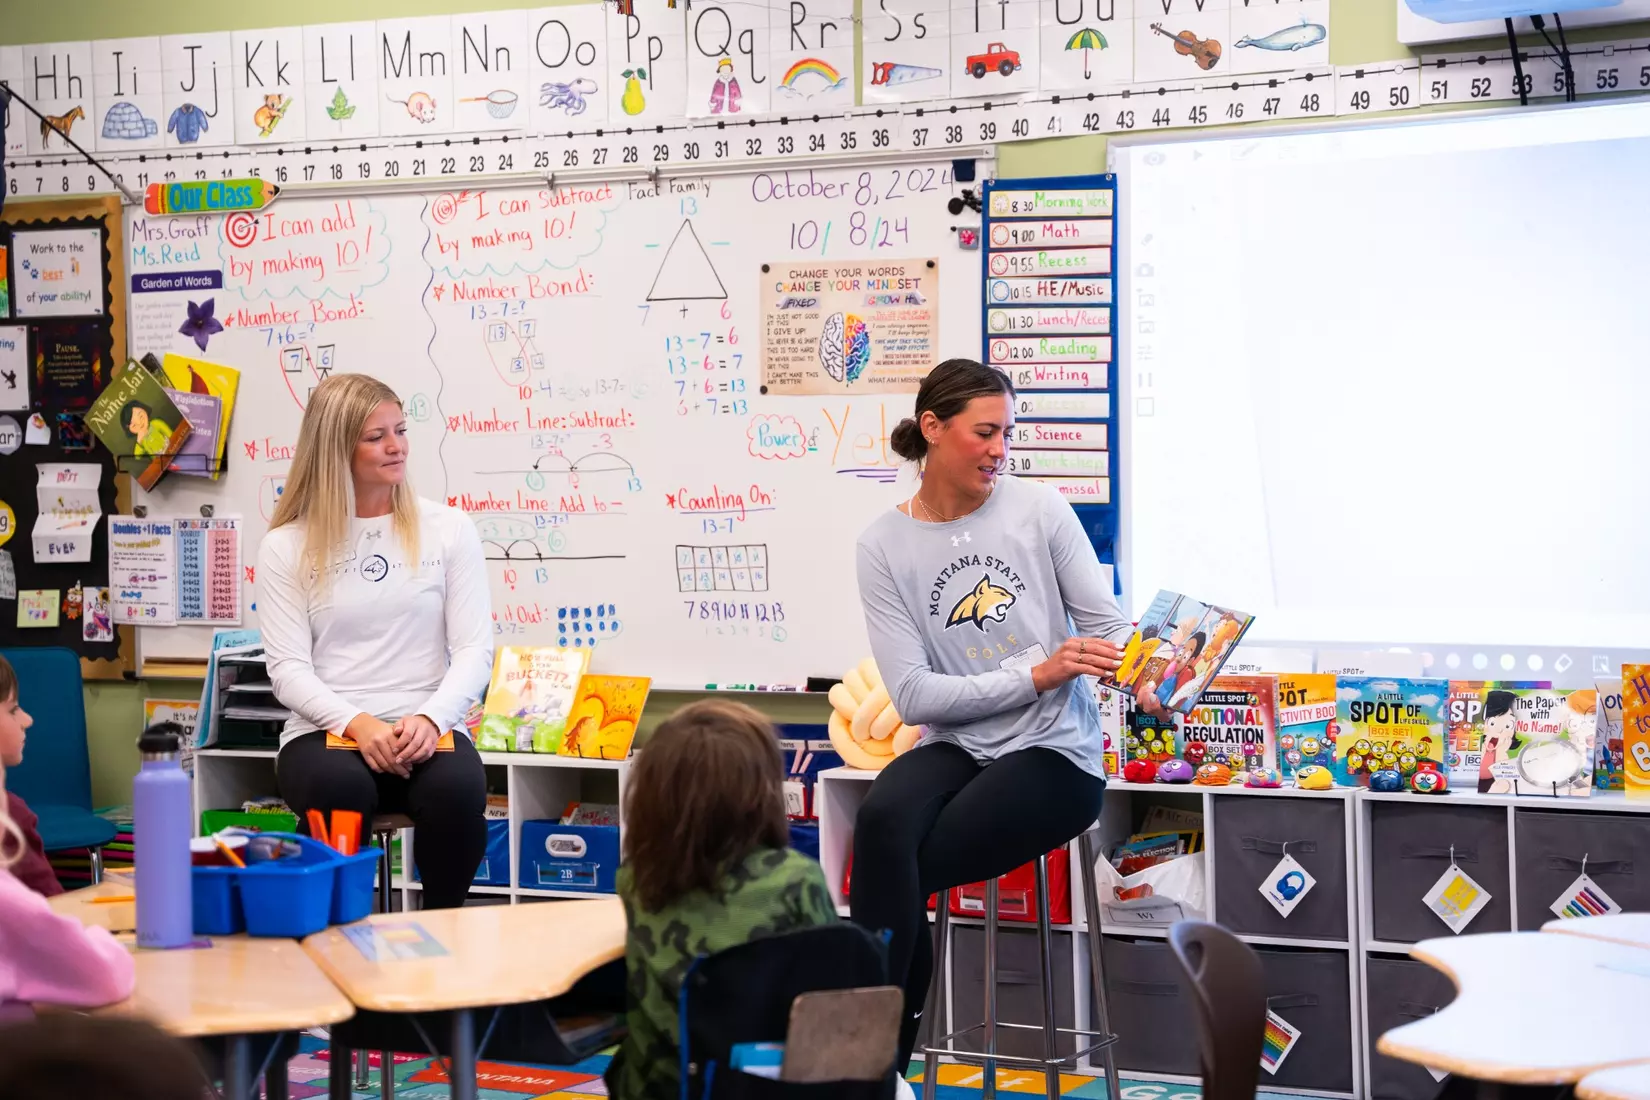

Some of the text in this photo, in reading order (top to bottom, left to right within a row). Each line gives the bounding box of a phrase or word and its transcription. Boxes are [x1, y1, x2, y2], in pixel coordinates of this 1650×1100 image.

[34, 54, 82, 100] Hh
[112, 51, 137, 96] Ii
[180, 46, 218, 117] Jj
[245, 40, 291, 87] Kk
[383, 30, 445, 78] Mm
[463, 24, 510, 73] Nn
[536, 20, 596, 68] Oo
[626, 15, 662, 90] Pp
[694, 7, 766, 83] Qq
[790, 2, 836, 50] Rr
[880, 0, 926, 41] Ss
[11, 69, 1618, 194] 6 7 8 9 11 16 18 20 21 23 25 27 29 30 32 34 36 38 40 42 44 46 47 48 49 50 51 52 55
[169, 182, 253, 210] Our Class
[628, 181, 660, 200] Fact
[752, 168, 955, 205] October 8, 2024
[475, 183, 612, 221] I can Subtract
[1034, 192, 1083, 214] Morning
[263, 200, 356, 241] I can add
[436, 210, 576, 260] by making 10!
[1042, 224, 1080, 238] Math
[30, 243, 84, 255] Work to the
[230, 255, 253, 285] by
[263, 249, 326, 282] making
[1038, 251, 1087, 268] Recess
[141, 276, 212, 289] Garden of Words
[789, 267, 905, 279] CHANGE YOUR WORDS
[453, 268, 595, 301] Number Bond:
[775, 278, 921, 293] CHANGE YOUR MINDSET
[26, 290, 92, 304] of your ability!
[787, 299, 817, 307] FIXED
[237, 293, 365, 328] Number Bond:
[1040, 338, 1098, 360] Reading
[1034, 366, 1090, 386] Writing
[90, 367, 146, 434] Name Jar
[462, 407, 519, 433] Number
[758, 402, 900, 466] Power of Yet
[1035, 426, 1082, 440] Science
[461, 491, 511, 512] Number
[560, 494, 585, 512] Add
[593, 494, 607, 511] to
[678, 485, 746, 521] Counting
[113, 523, 141, 535] Doubles
[151, 524, 171, 535] Facts
[49, 542, 76, 555] EVER
[930, 554, 1026, 616] MONTANA STATE
[966, 634, 1018, 659] GOLF
[1350, 701, 1421, 724] SPOT OF
[1516, 696, 1567, 712] The Paper
[1530, 709, 1549, 719] with
[1184, 727, 1264, 744] REGULATION
[1371, 727, 1409, 736] BOX SET
[1516, 721, 1562, 734] No Name!
[1226, 745, 1240, 753] SET
[560, 870, 573, 879] 2B
